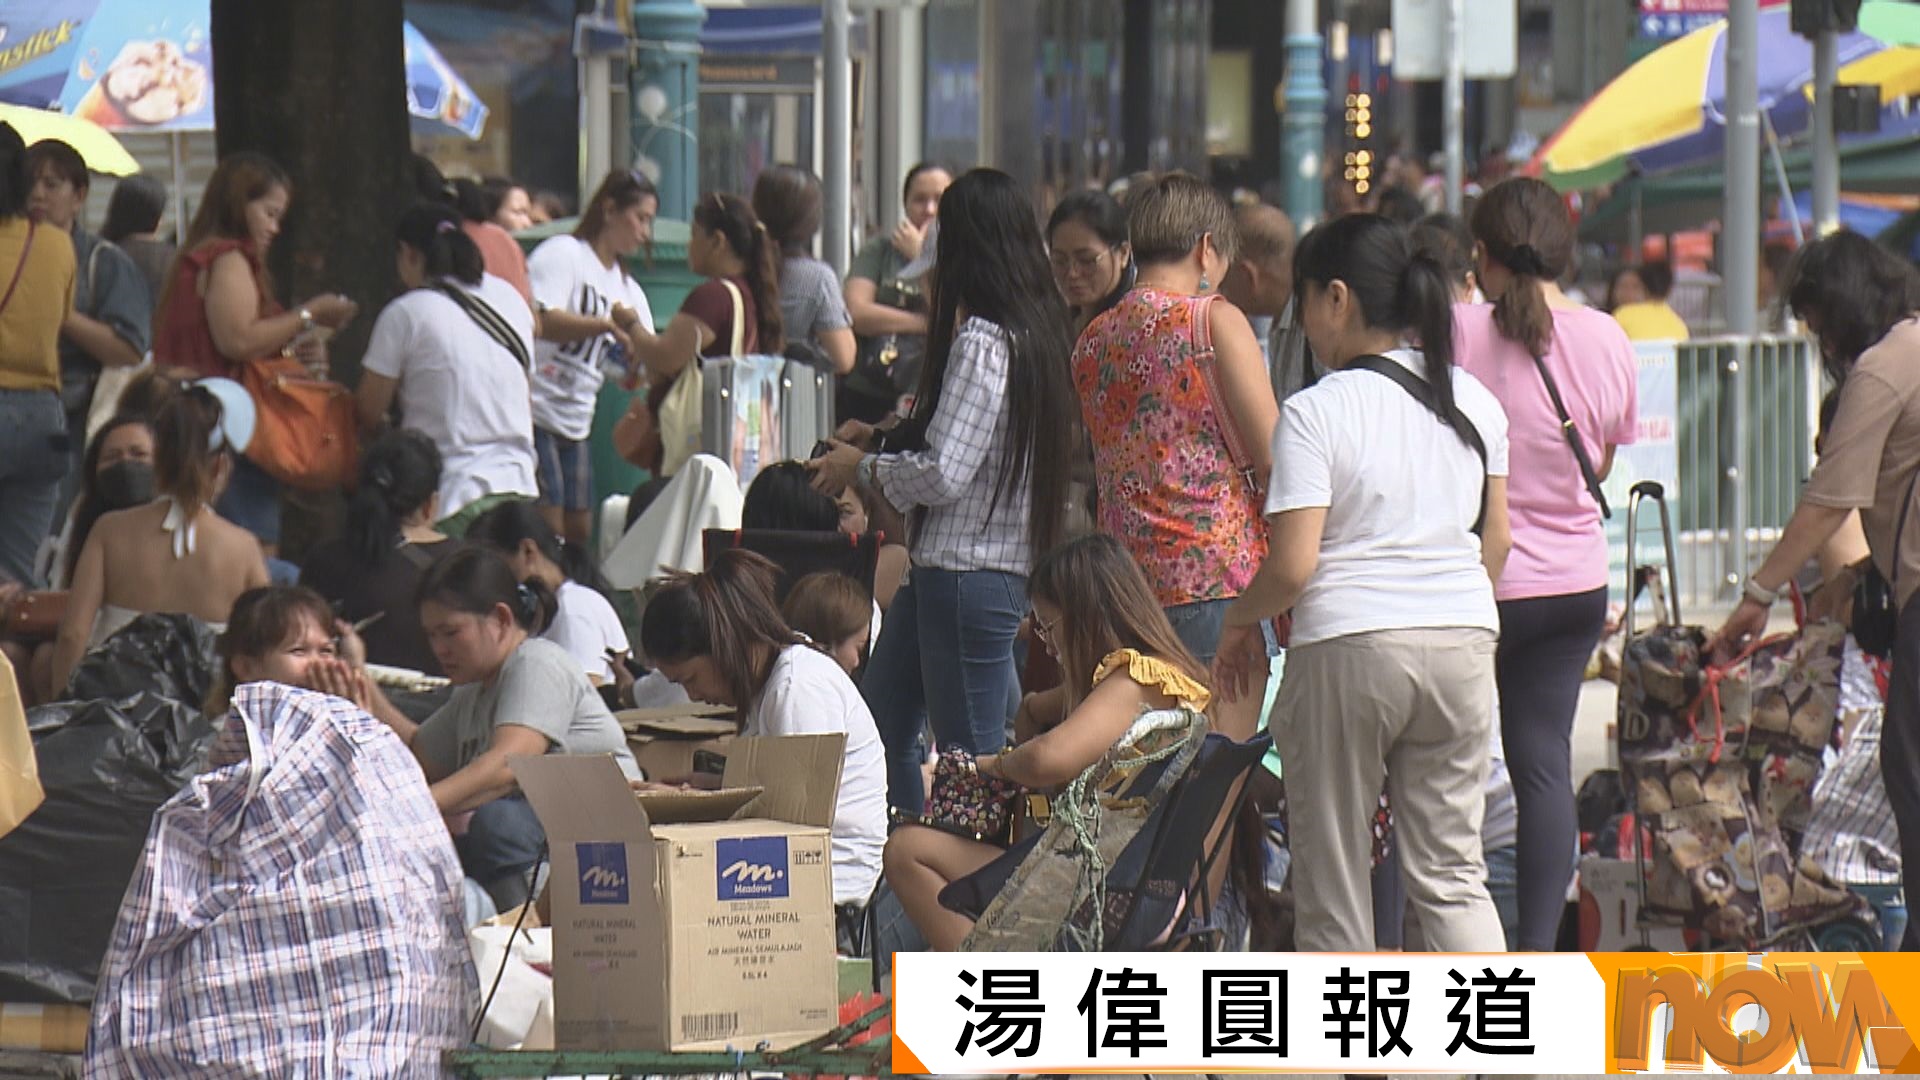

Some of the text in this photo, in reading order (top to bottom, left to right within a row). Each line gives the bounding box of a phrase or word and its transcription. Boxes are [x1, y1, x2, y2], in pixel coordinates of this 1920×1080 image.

[734, 883, 773, 895] Meadows
[707, 912, 800, 928] NATURAL MINERAL
[737, 928, 771, 941] WATER
